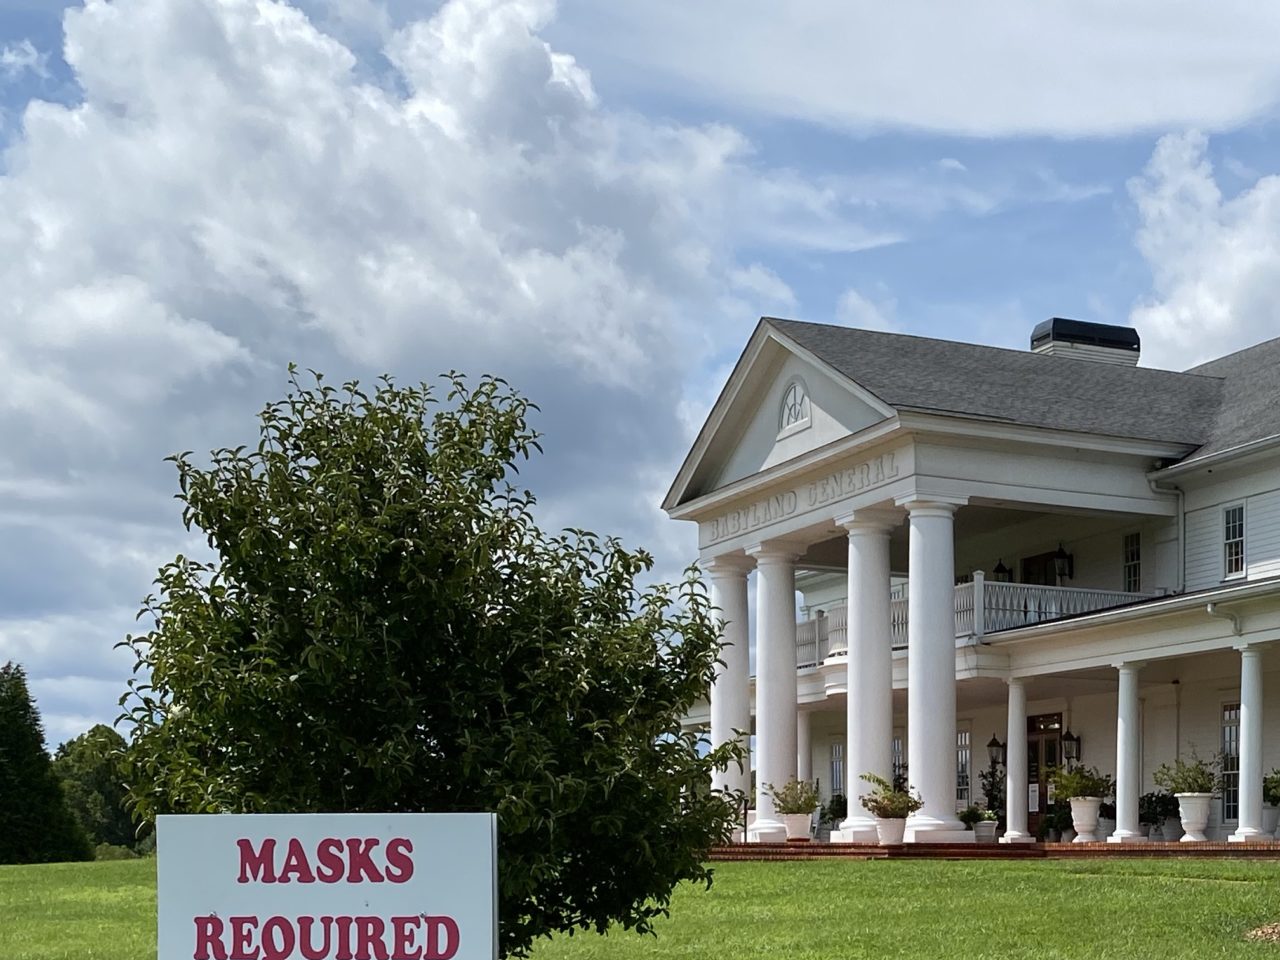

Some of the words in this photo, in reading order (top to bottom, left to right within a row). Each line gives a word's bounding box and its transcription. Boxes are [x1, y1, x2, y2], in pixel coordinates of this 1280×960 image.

[710, 490, 797, 541] BABYLAND
[808, 453, 899, 506] GENERAL
[237, 838, 414, 883] MASKS
